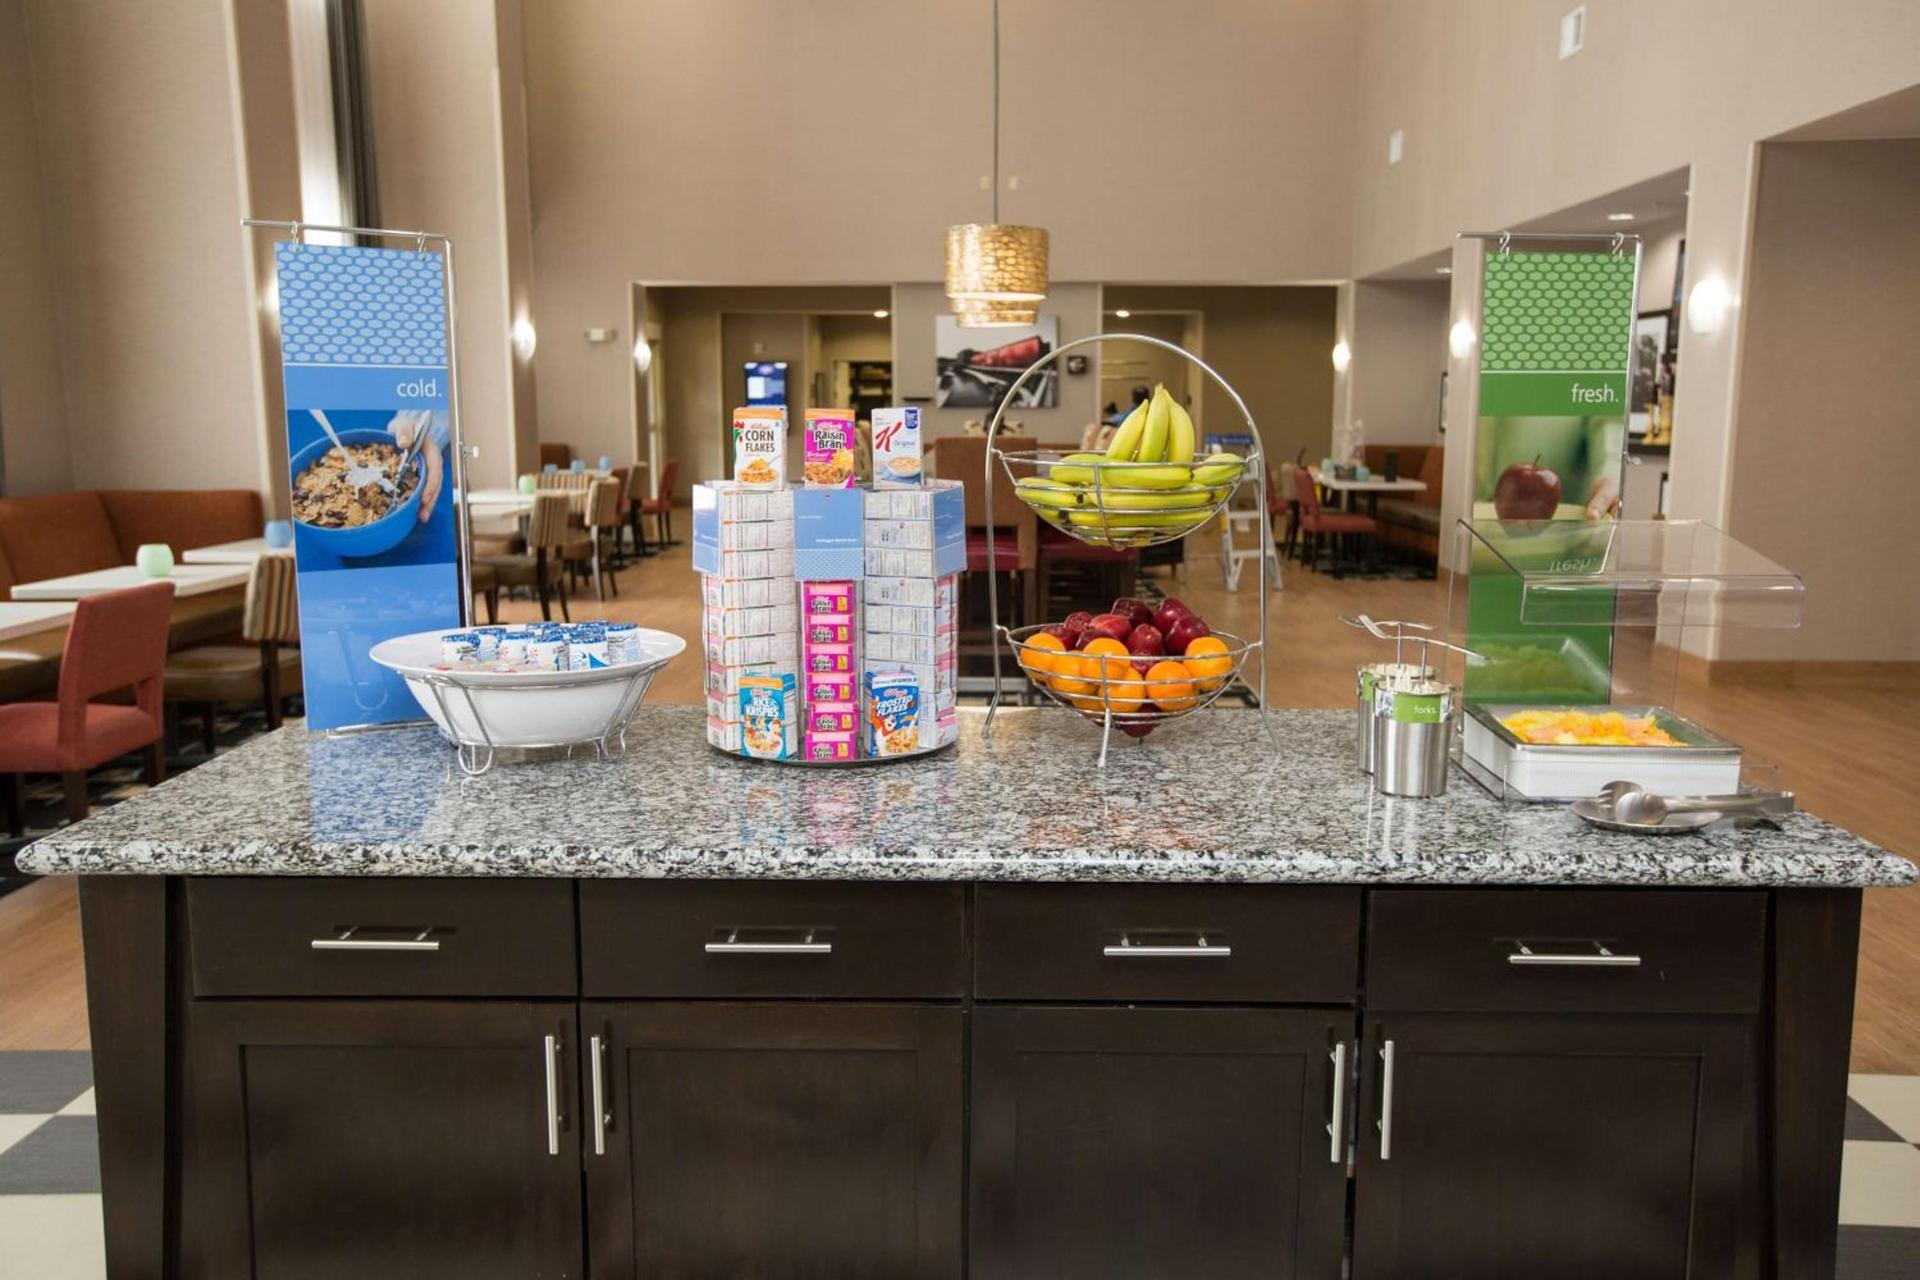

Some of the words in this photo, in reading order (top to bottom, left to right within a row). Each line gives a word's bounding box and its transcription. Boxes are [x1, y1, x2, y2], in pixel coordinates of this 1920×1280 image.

[396, 378, 442, 397] cold.
[1571, 382, 1619, 403] fresh.
[745, 430, 774, 441] CORN
[815, 430, 845, 441] Raisin
[875, 421, 902, 453] K
[745, 442, 775, 453] FLAKES
[818, 440, 842, 449] Bran
[877, 694, 913, 710] FROSTED
